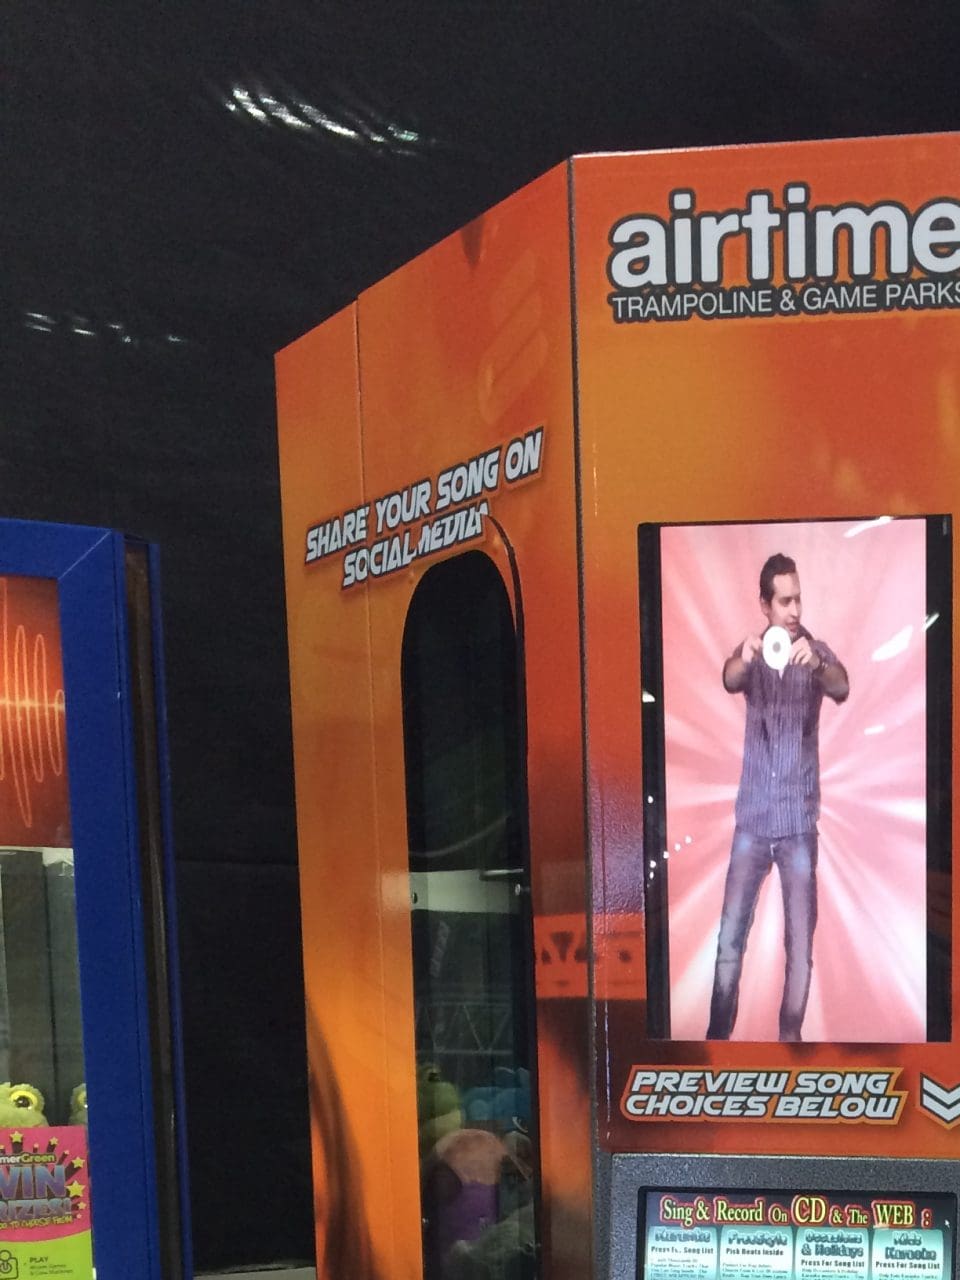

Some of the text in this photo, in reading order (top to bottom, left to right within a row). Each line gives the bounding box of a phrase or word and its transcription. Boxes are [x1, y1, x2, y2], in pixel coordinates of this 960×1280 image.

[612, 290, 772, 318] TRAMPOLINE
[779, 290, 796, 311] &
[804, 284, 879, 310] GAME
[305, 431, 542, 562] SHARE YOUR SONG ON
[343, 536, 417, 587] SOCIAL
[631, 1071, 891, 1095] PREVIEW SONG
[625, 1094, 900, 1118] CHOICES BELOW
[664, 1199, 694, 1227] Sing
[695, 1200, 711, 1221] &
[716, 1200, 764, 1222] Record
[772, 1207, 788, 1223] On
[794, 1197, 826, 1223] CD
[832, 1210, 843, 1224] &
[848, 1208, 869, 1224] The
[875, 1204, 914, 1225] WEB
[29, 1256, 49, 1264] PLAY
[834, 1260, 852, 1268] Song
